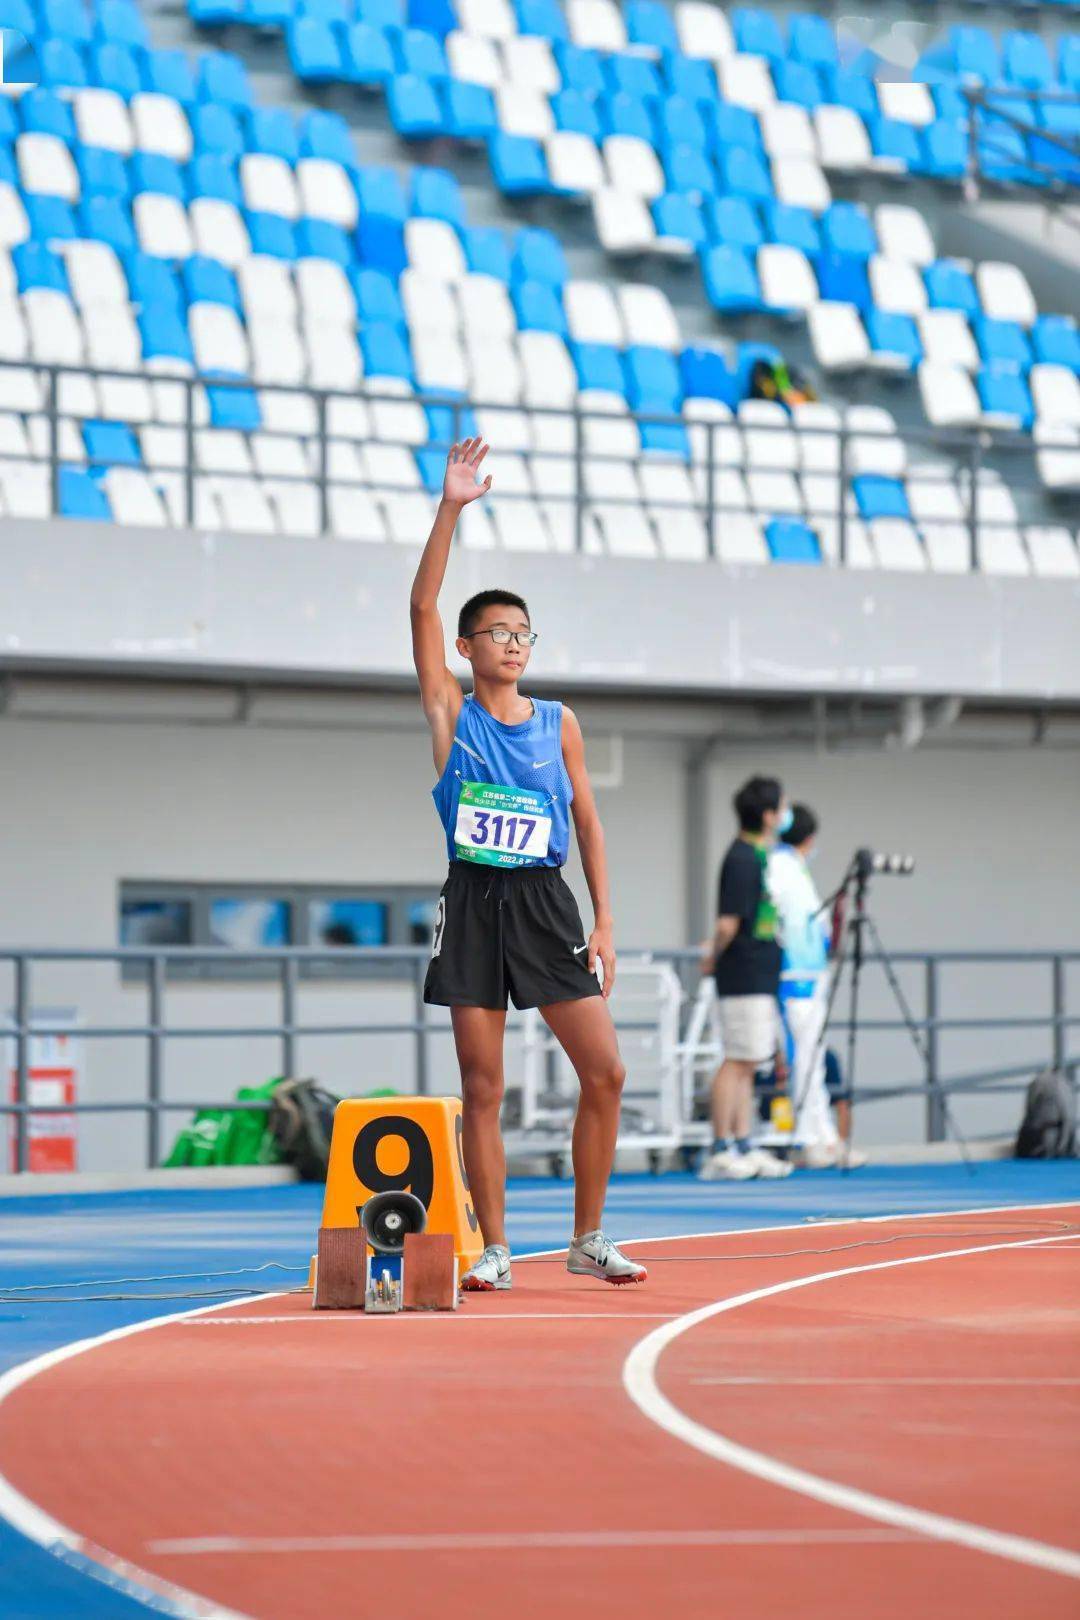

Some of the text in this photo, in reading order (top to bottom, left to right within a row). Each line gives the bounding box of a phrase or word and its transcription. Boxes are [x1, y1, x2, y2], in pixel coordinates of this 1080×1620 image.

[470, 811, 537, 850] 3117
[498, 855, 524, 865] 2022.8
[352, 1115, 434, 1220] 9
